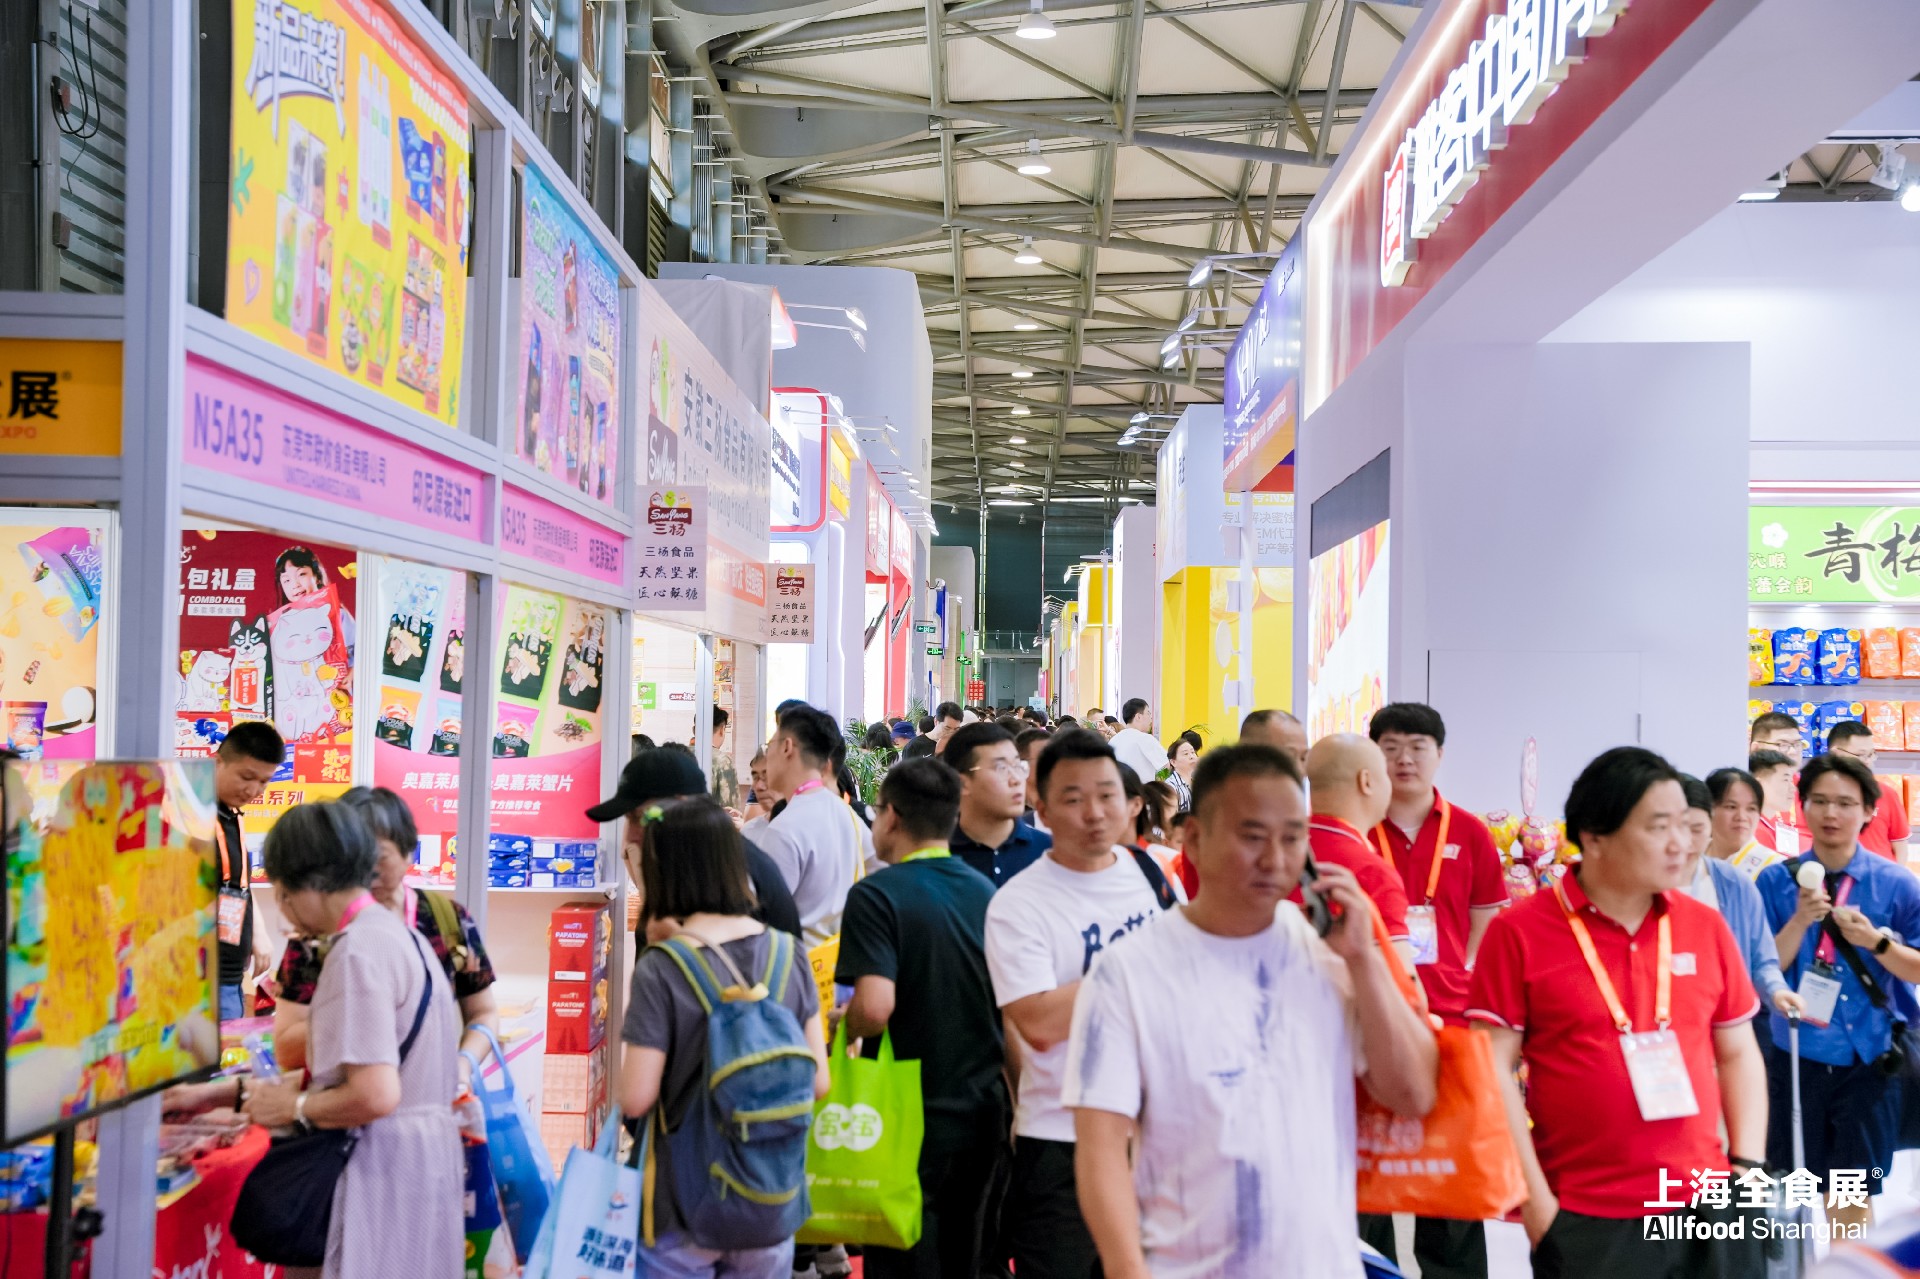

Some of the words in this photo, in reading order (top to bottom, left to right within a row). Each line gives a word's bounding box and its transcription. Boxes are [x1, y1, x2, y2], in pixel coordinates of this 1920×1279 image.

[193, 392, 264, 465] N5A35
[652, 523, 687, 537] 三杨
[645, 547, 694, 558] 三杨食品
[638, 566, 699, 579] 天然坚果
[779, 587, 802, 597] 三杨
[189, 596, 221, 604] COMBO
[223, 596, 246, 604] PACK
[775, 602, 807, 610] 三杨食品
[770, 614, 809, 624] 天然坚果
